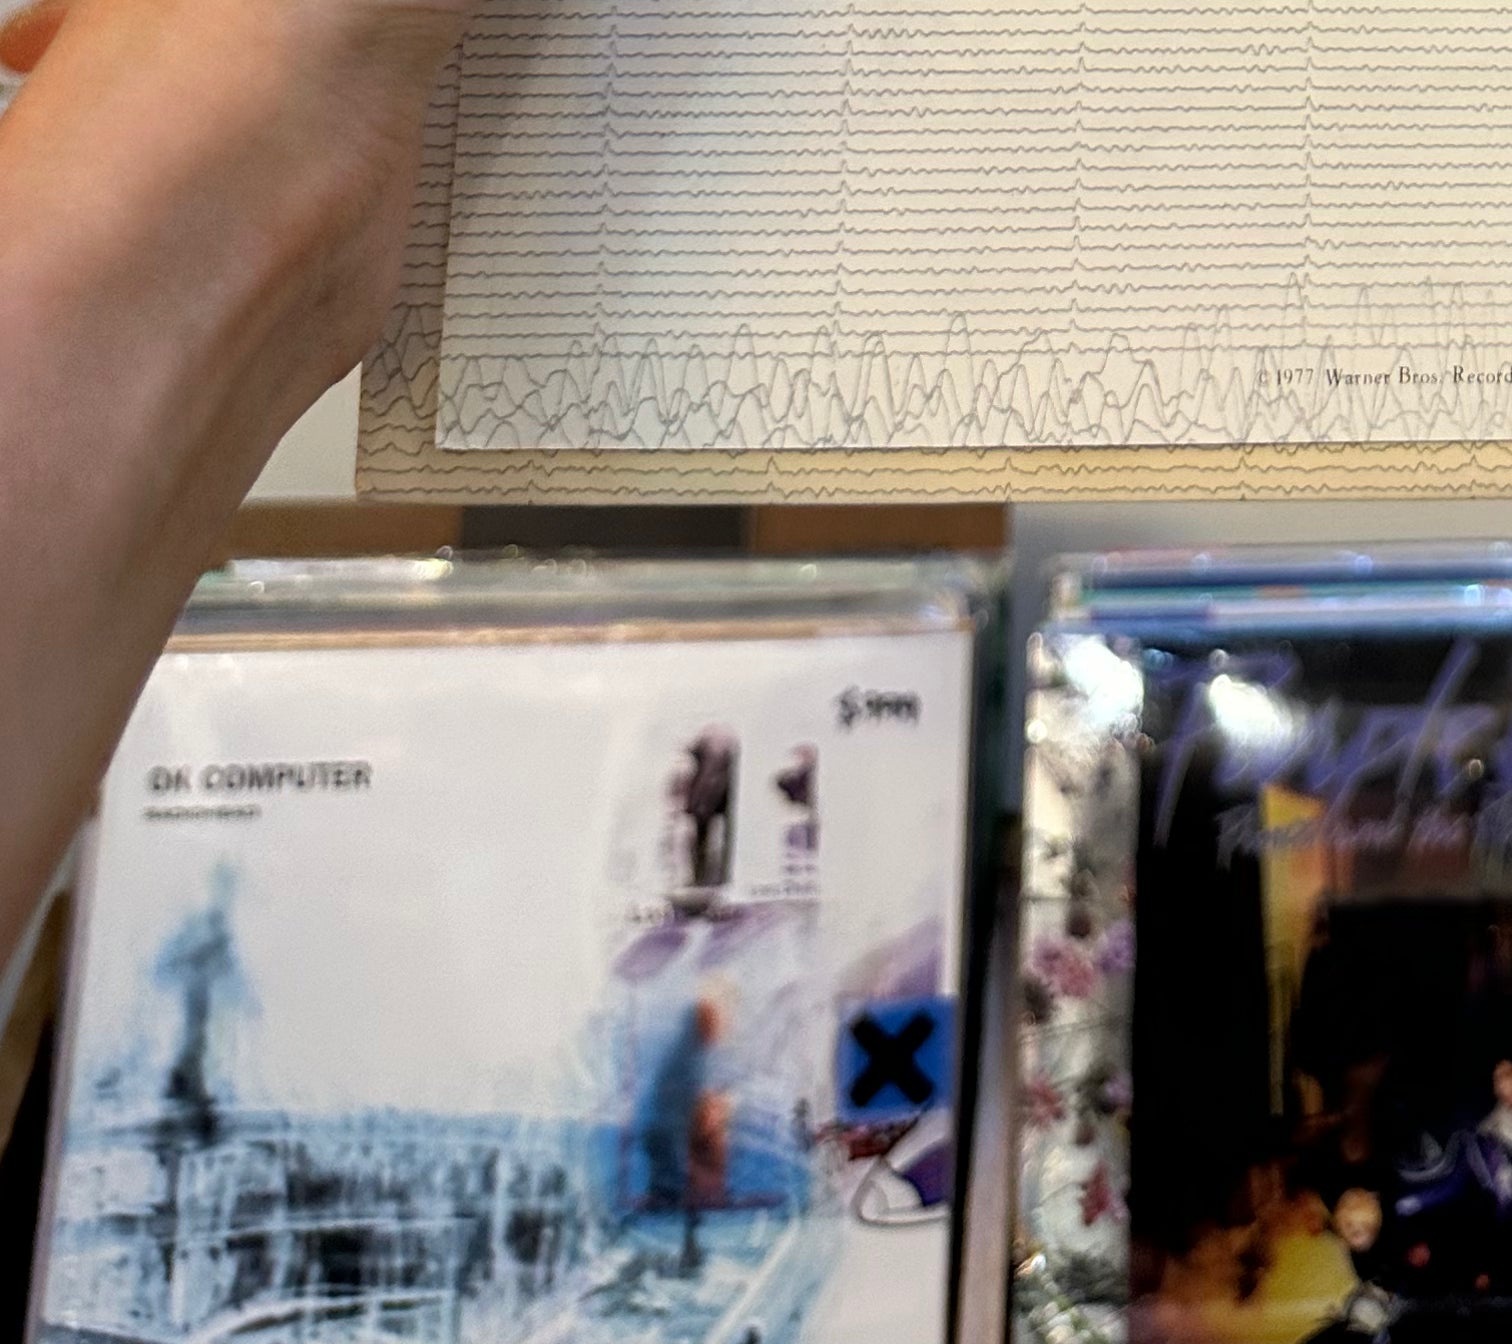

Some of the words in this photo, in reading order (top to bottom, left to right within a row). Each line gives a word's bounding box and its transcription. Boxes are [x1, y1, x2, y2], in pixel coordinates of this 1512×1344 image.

[1276, 368, 1314, 386] 1977
[1326, 368, 1390, 385] Warner
[1398, 367, 1442, 385] Bros.
[202, 760, 372, 792] COMPUTER
